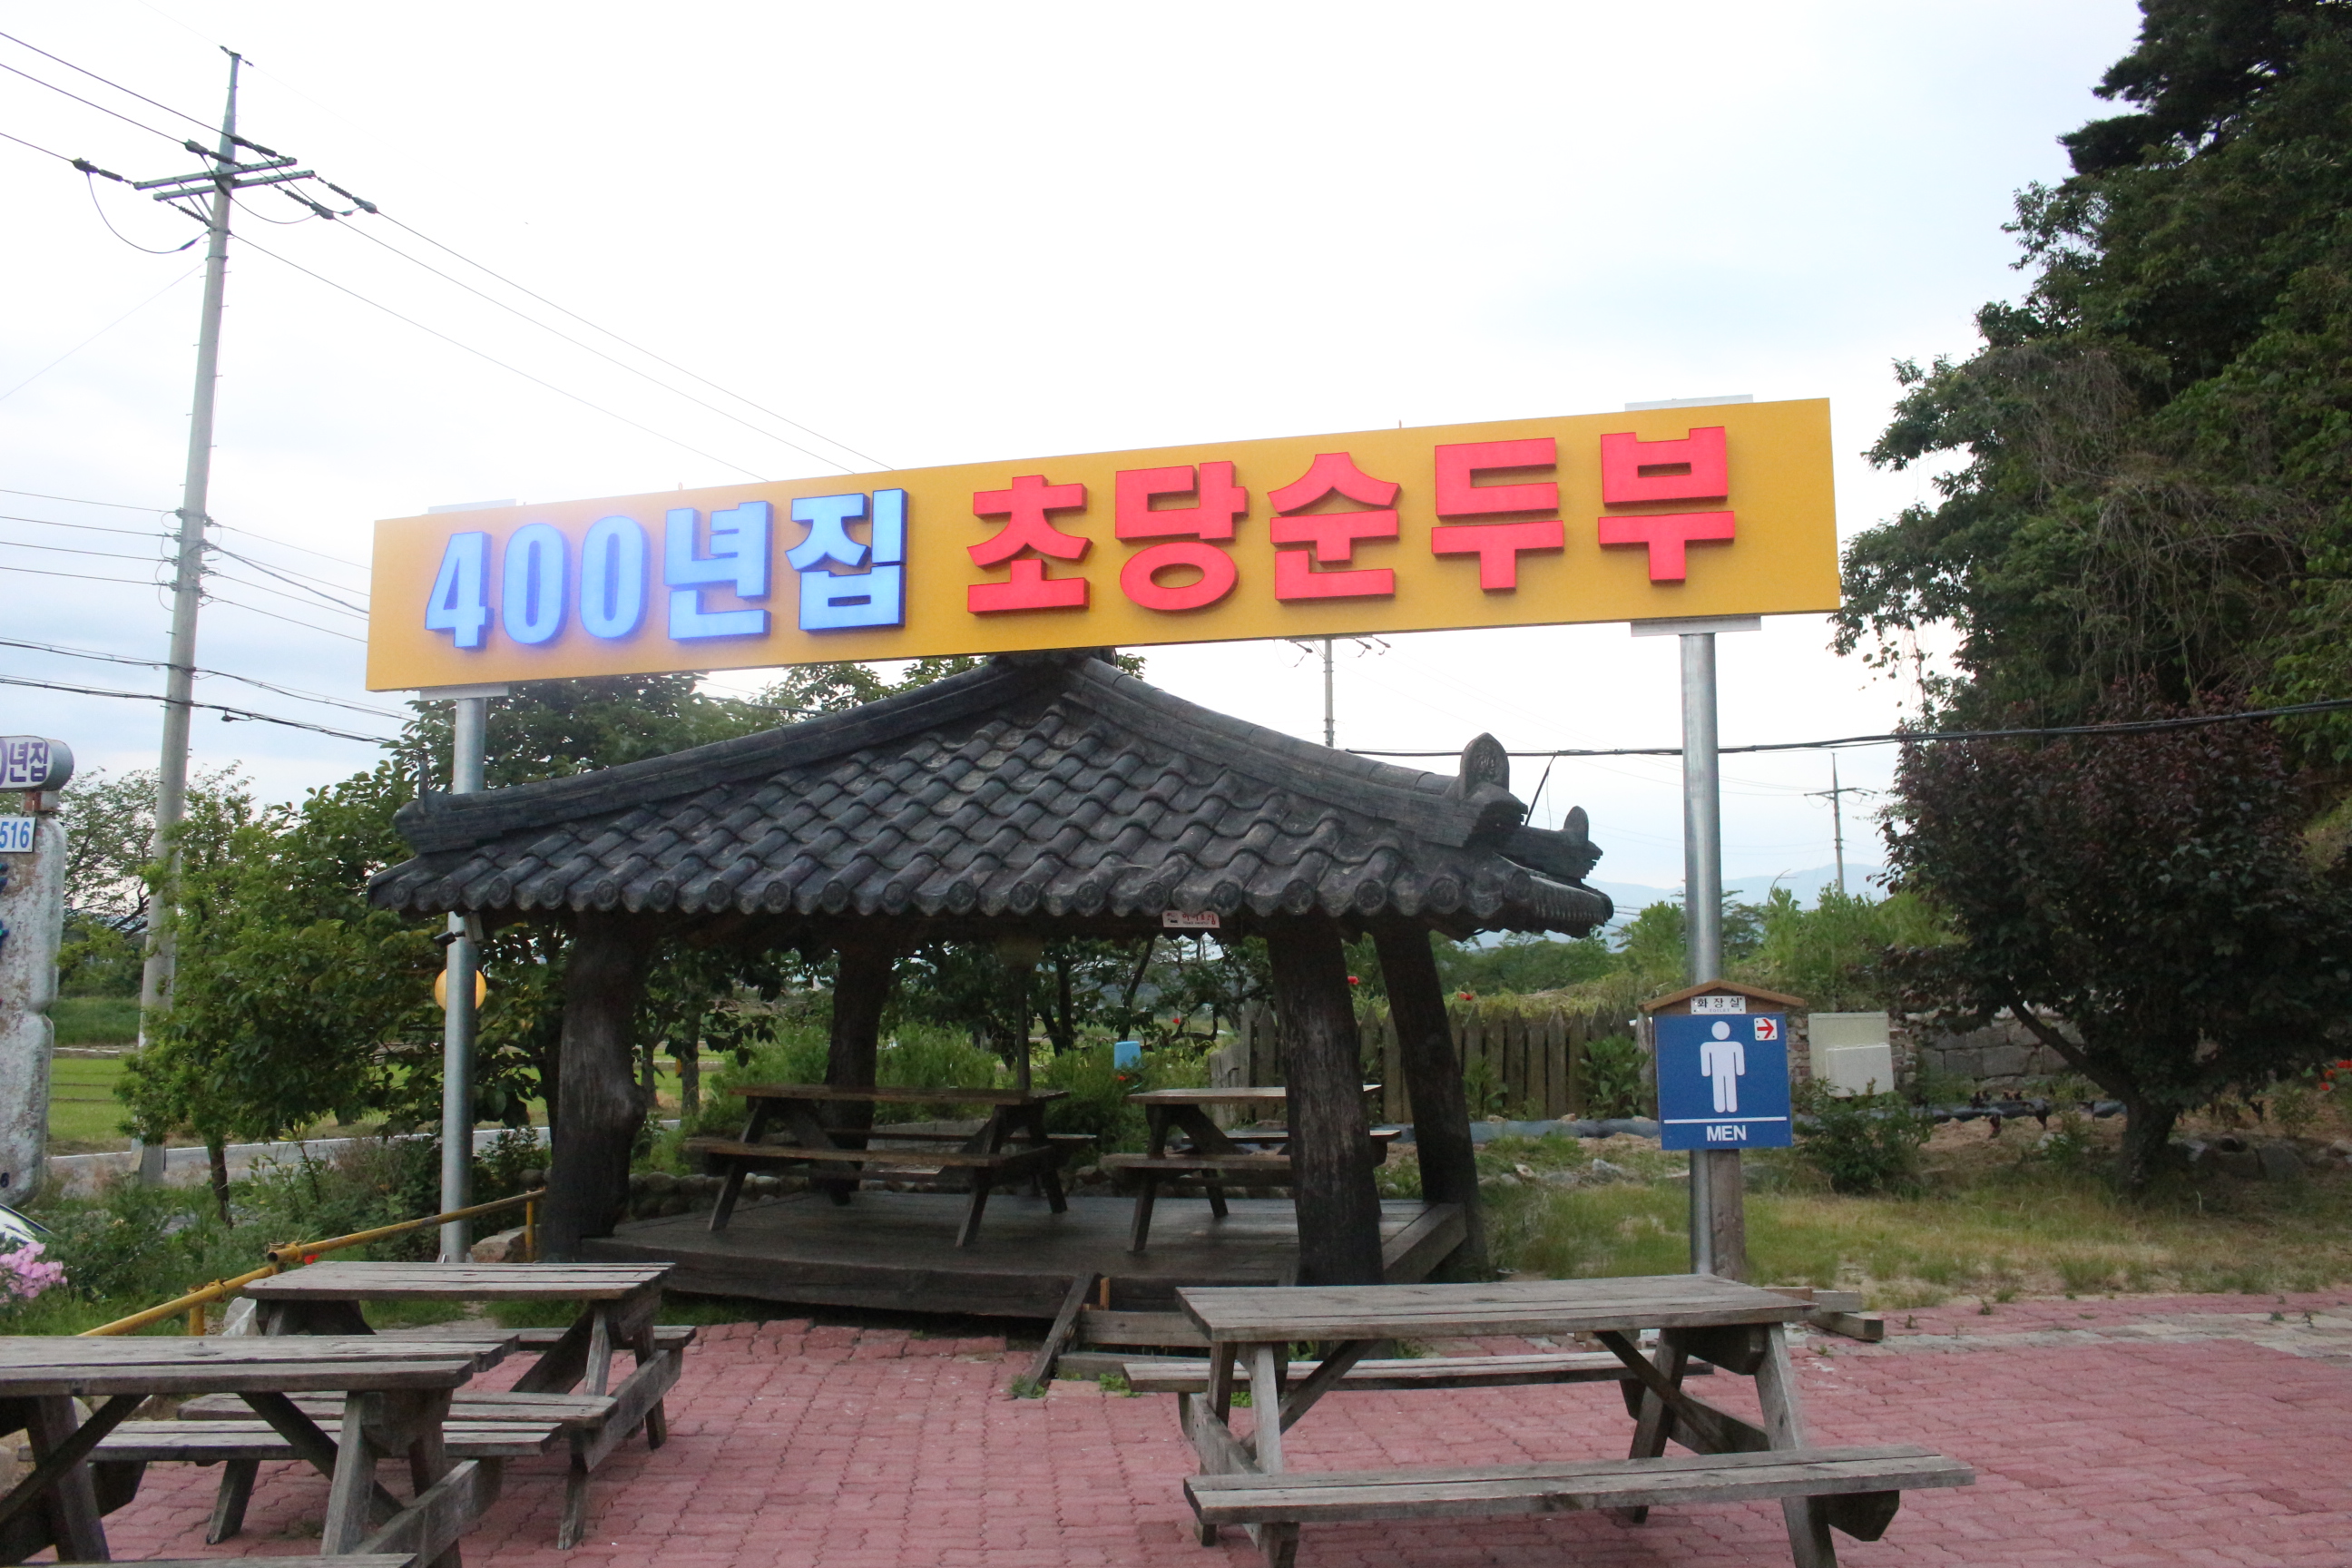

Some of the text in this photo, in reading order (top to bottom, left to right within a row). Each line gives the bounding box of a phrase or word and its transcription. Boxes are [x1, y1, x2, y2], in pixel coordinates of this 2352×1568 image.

[425, 426, 1735, 650] 400년집 초당순두부
[1697, 997, 1740, 1008] 화장실
[1706, 1125, 1747, 1142] MEN
